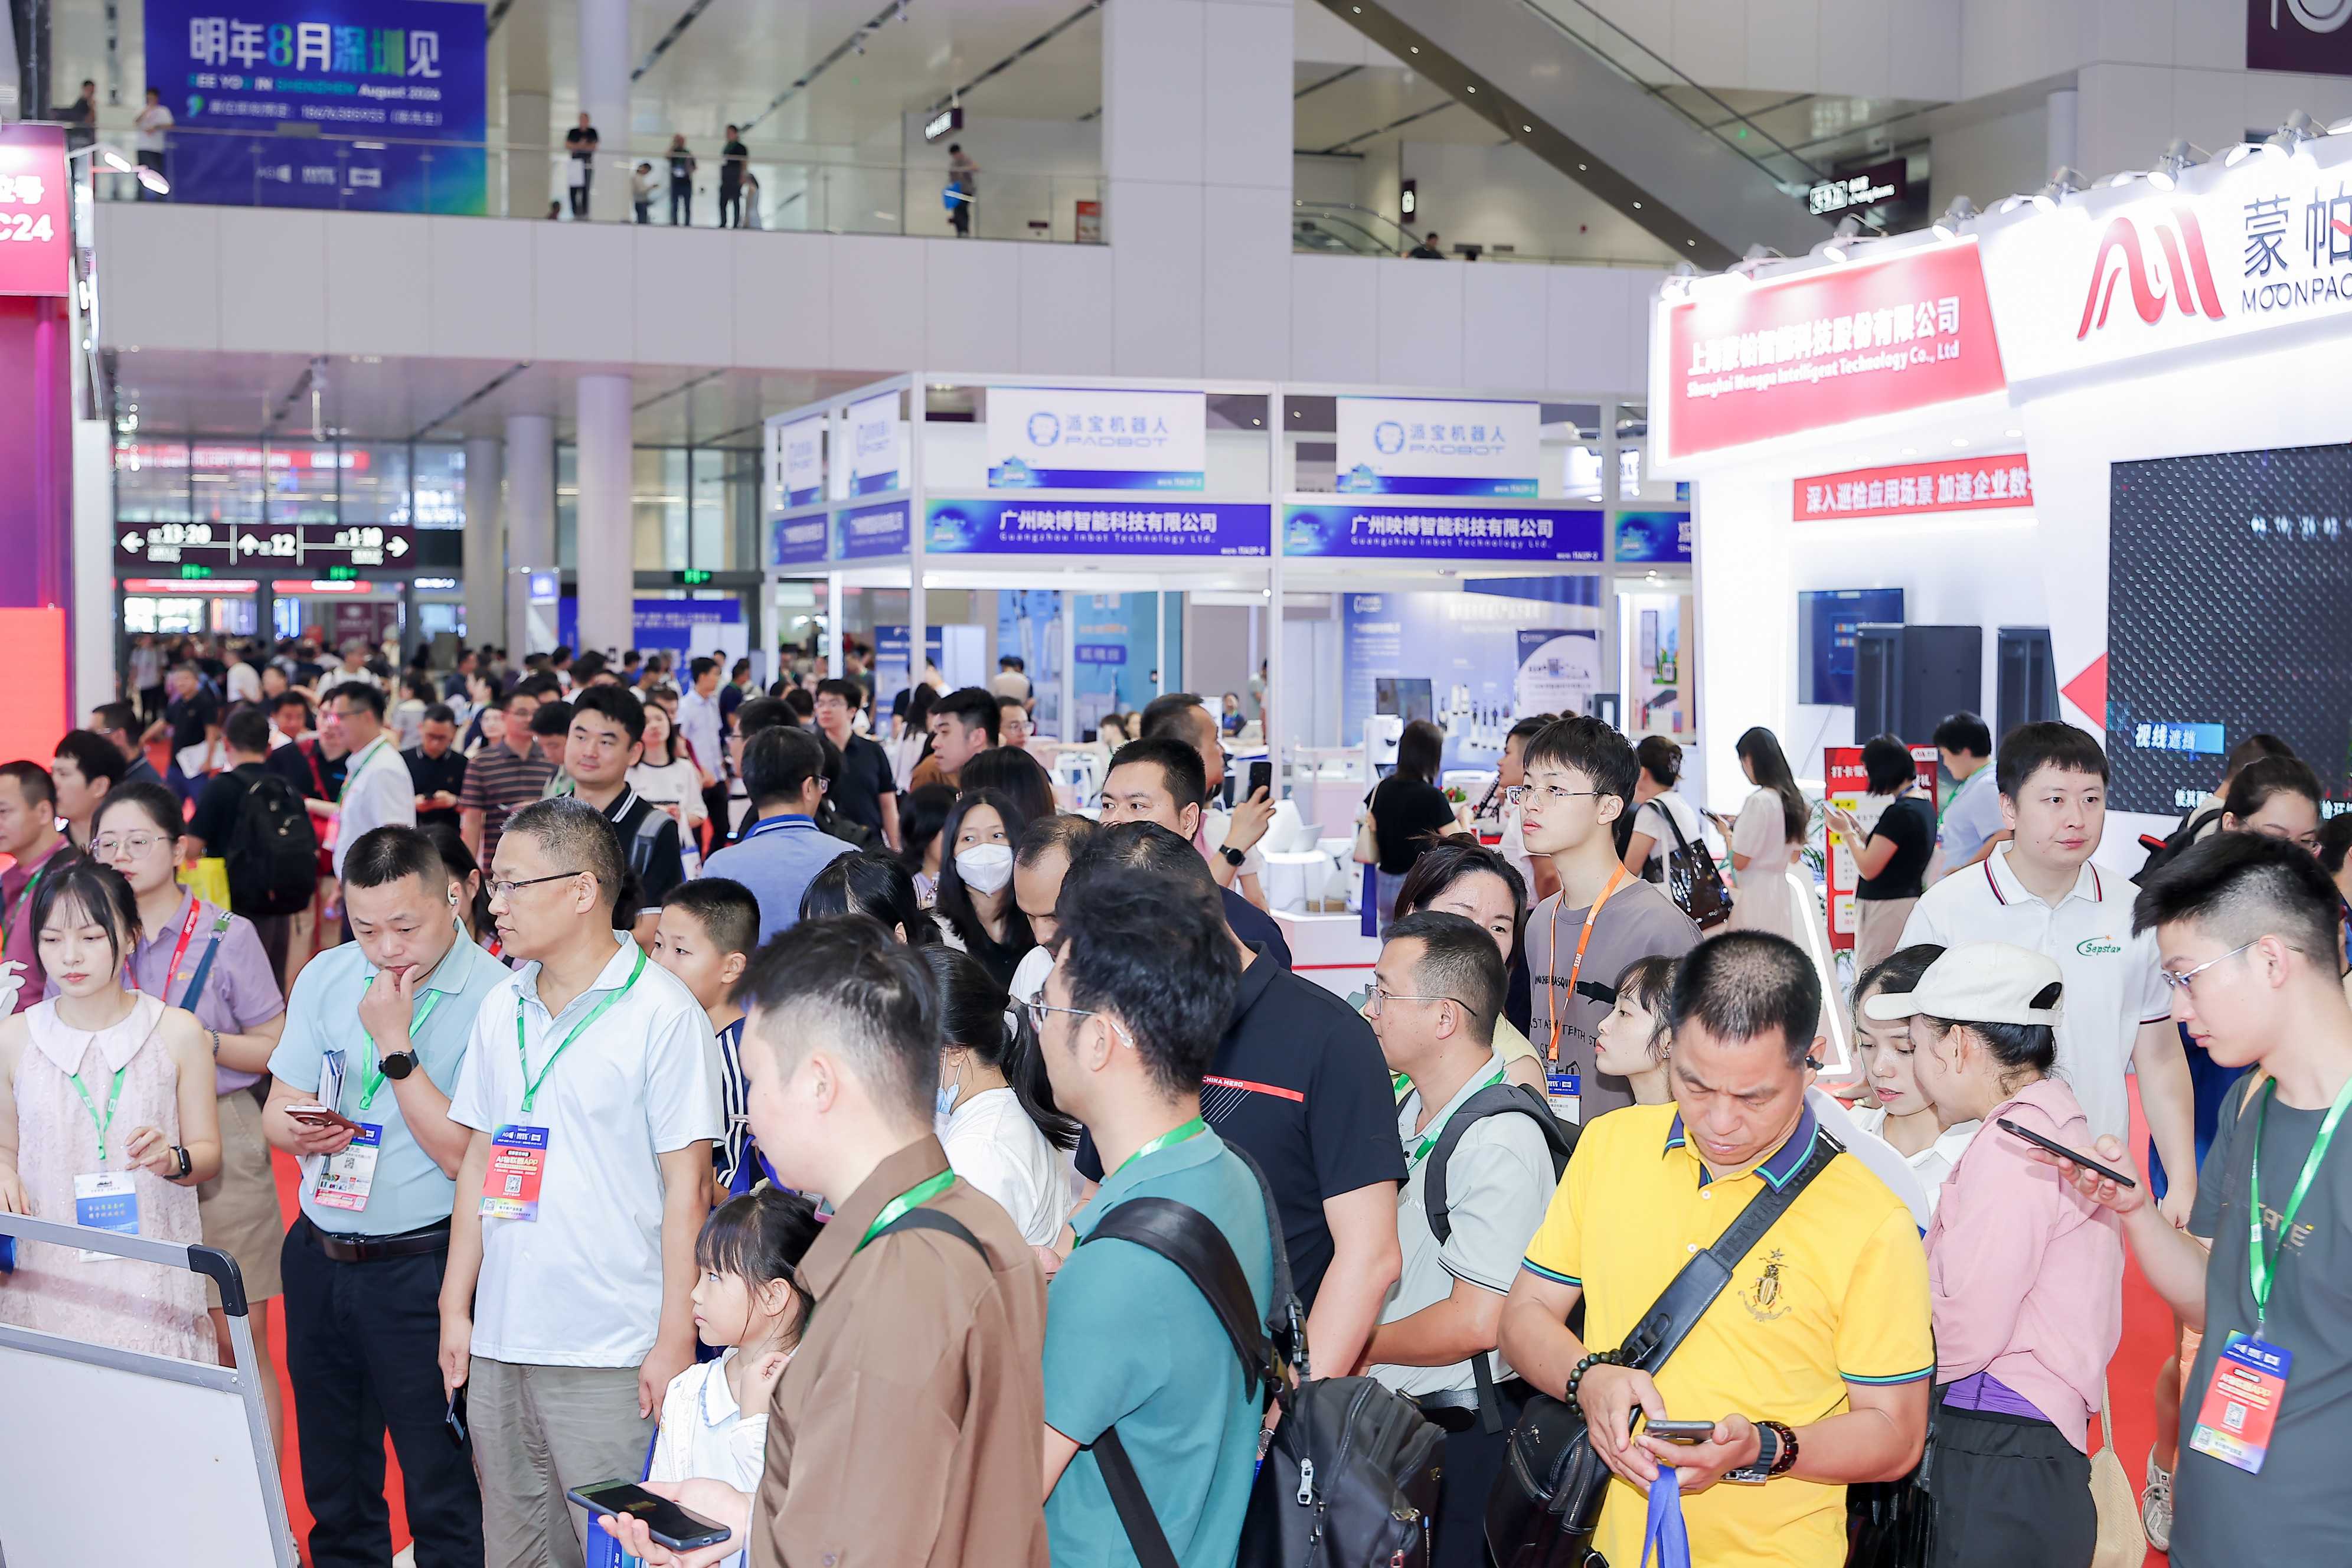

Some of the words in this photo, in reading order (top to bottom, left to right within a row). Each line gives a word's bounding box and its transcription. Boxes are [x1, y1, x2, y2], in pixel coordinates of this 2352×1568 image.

[190, 17, 442, 78] 明年8月深圳见
[254, 76, 273, 92] IN
[358, 83, 406, 100] August
[2243, 181, 2352, 279] 蒙帕
[1839, 350, 1909, 373] Technology
[1937, 339, 1961, 361] Ltd
[1064, 414, 1169, 434] 派宝机器人
[1409, 423, 1506, 442] 派宝机器人
[1064, 436, 1169, 447] PADBOT
[1409, 445, 1506, 456] PADBOT
[999, 532, 1069, 543] Guangzhou
[1115, 533, 1185, 545] Technology
[1223, 1080, 1243, 1088] HERO
